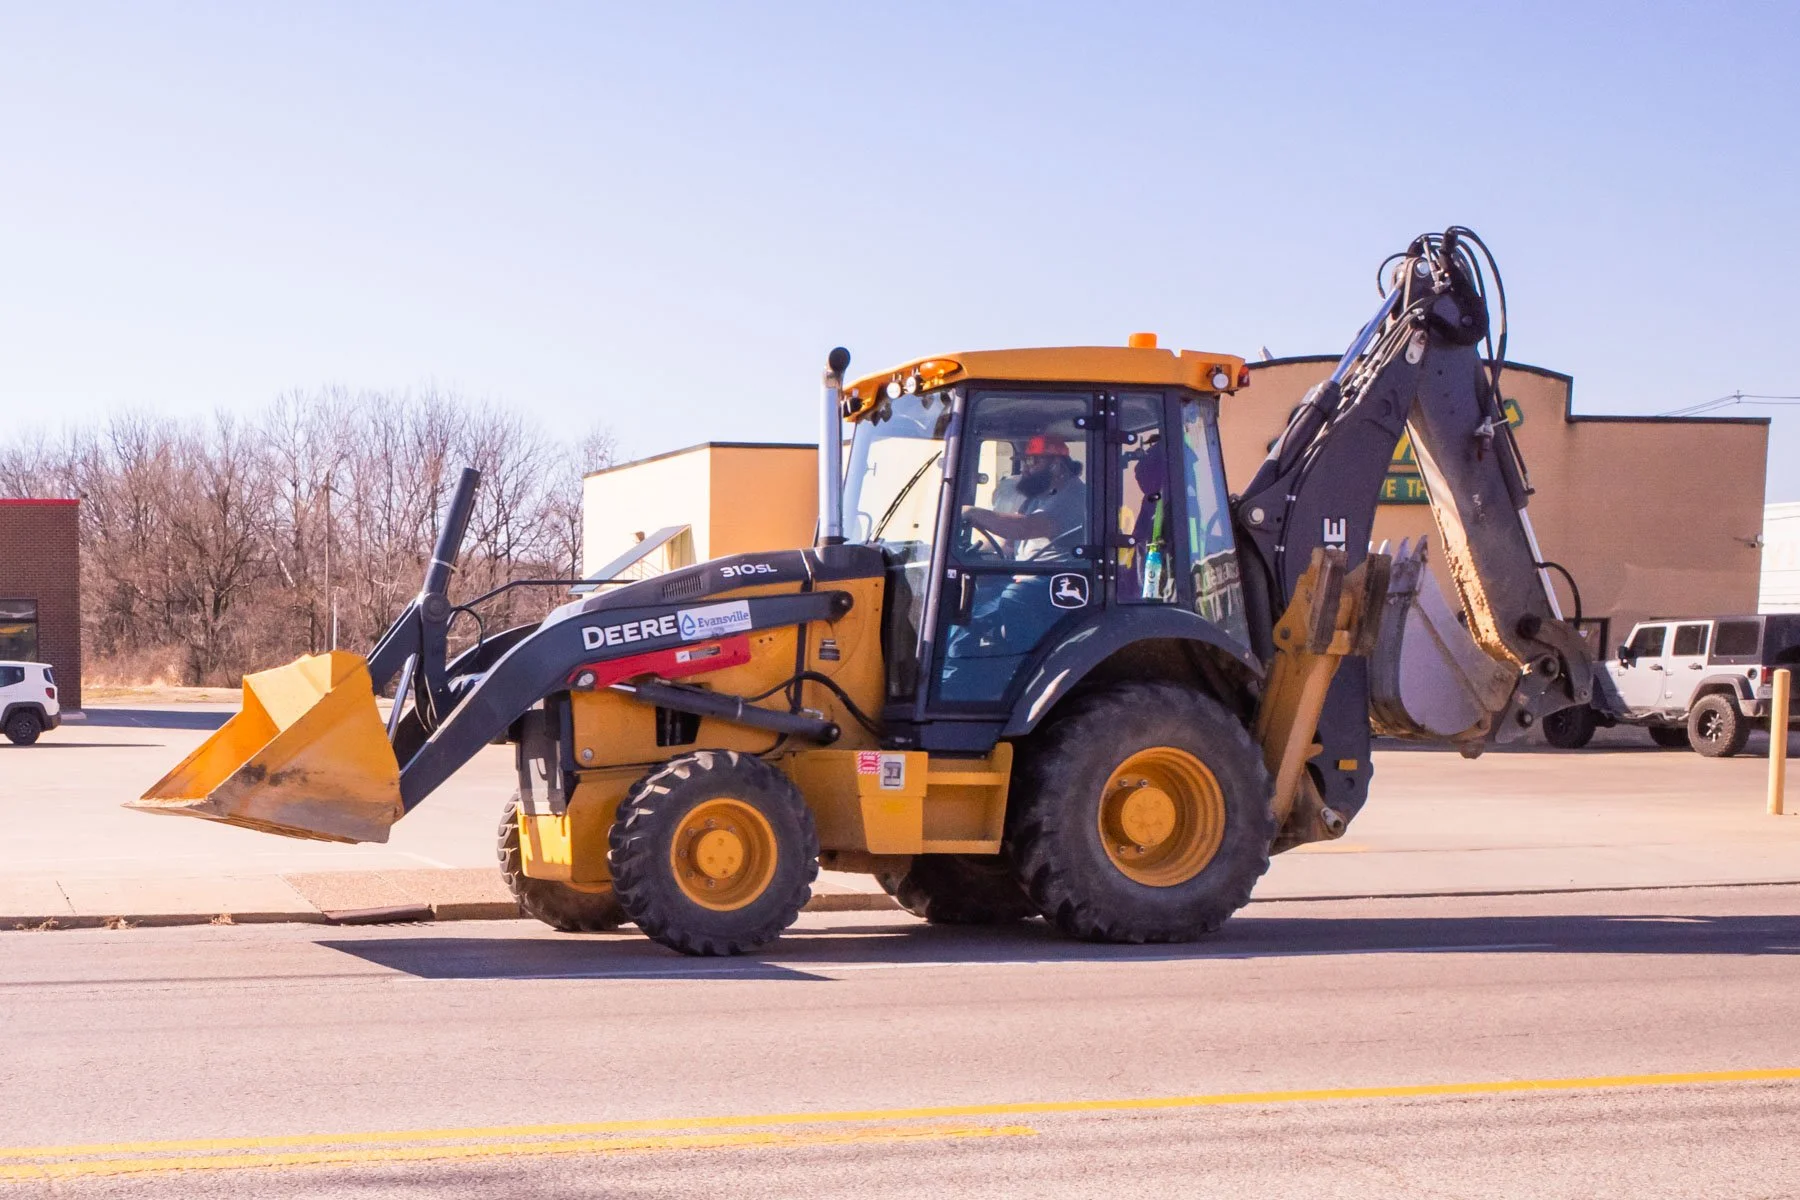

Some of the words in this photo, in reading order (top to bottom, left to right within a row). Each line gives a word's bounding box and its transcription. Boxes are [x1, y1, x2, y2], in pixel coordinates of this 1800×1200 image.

[720, 564, 777, 578] 310SL
[697, 610, 750, 628] Evansville
[582, 615, 678, 650] DEERE
